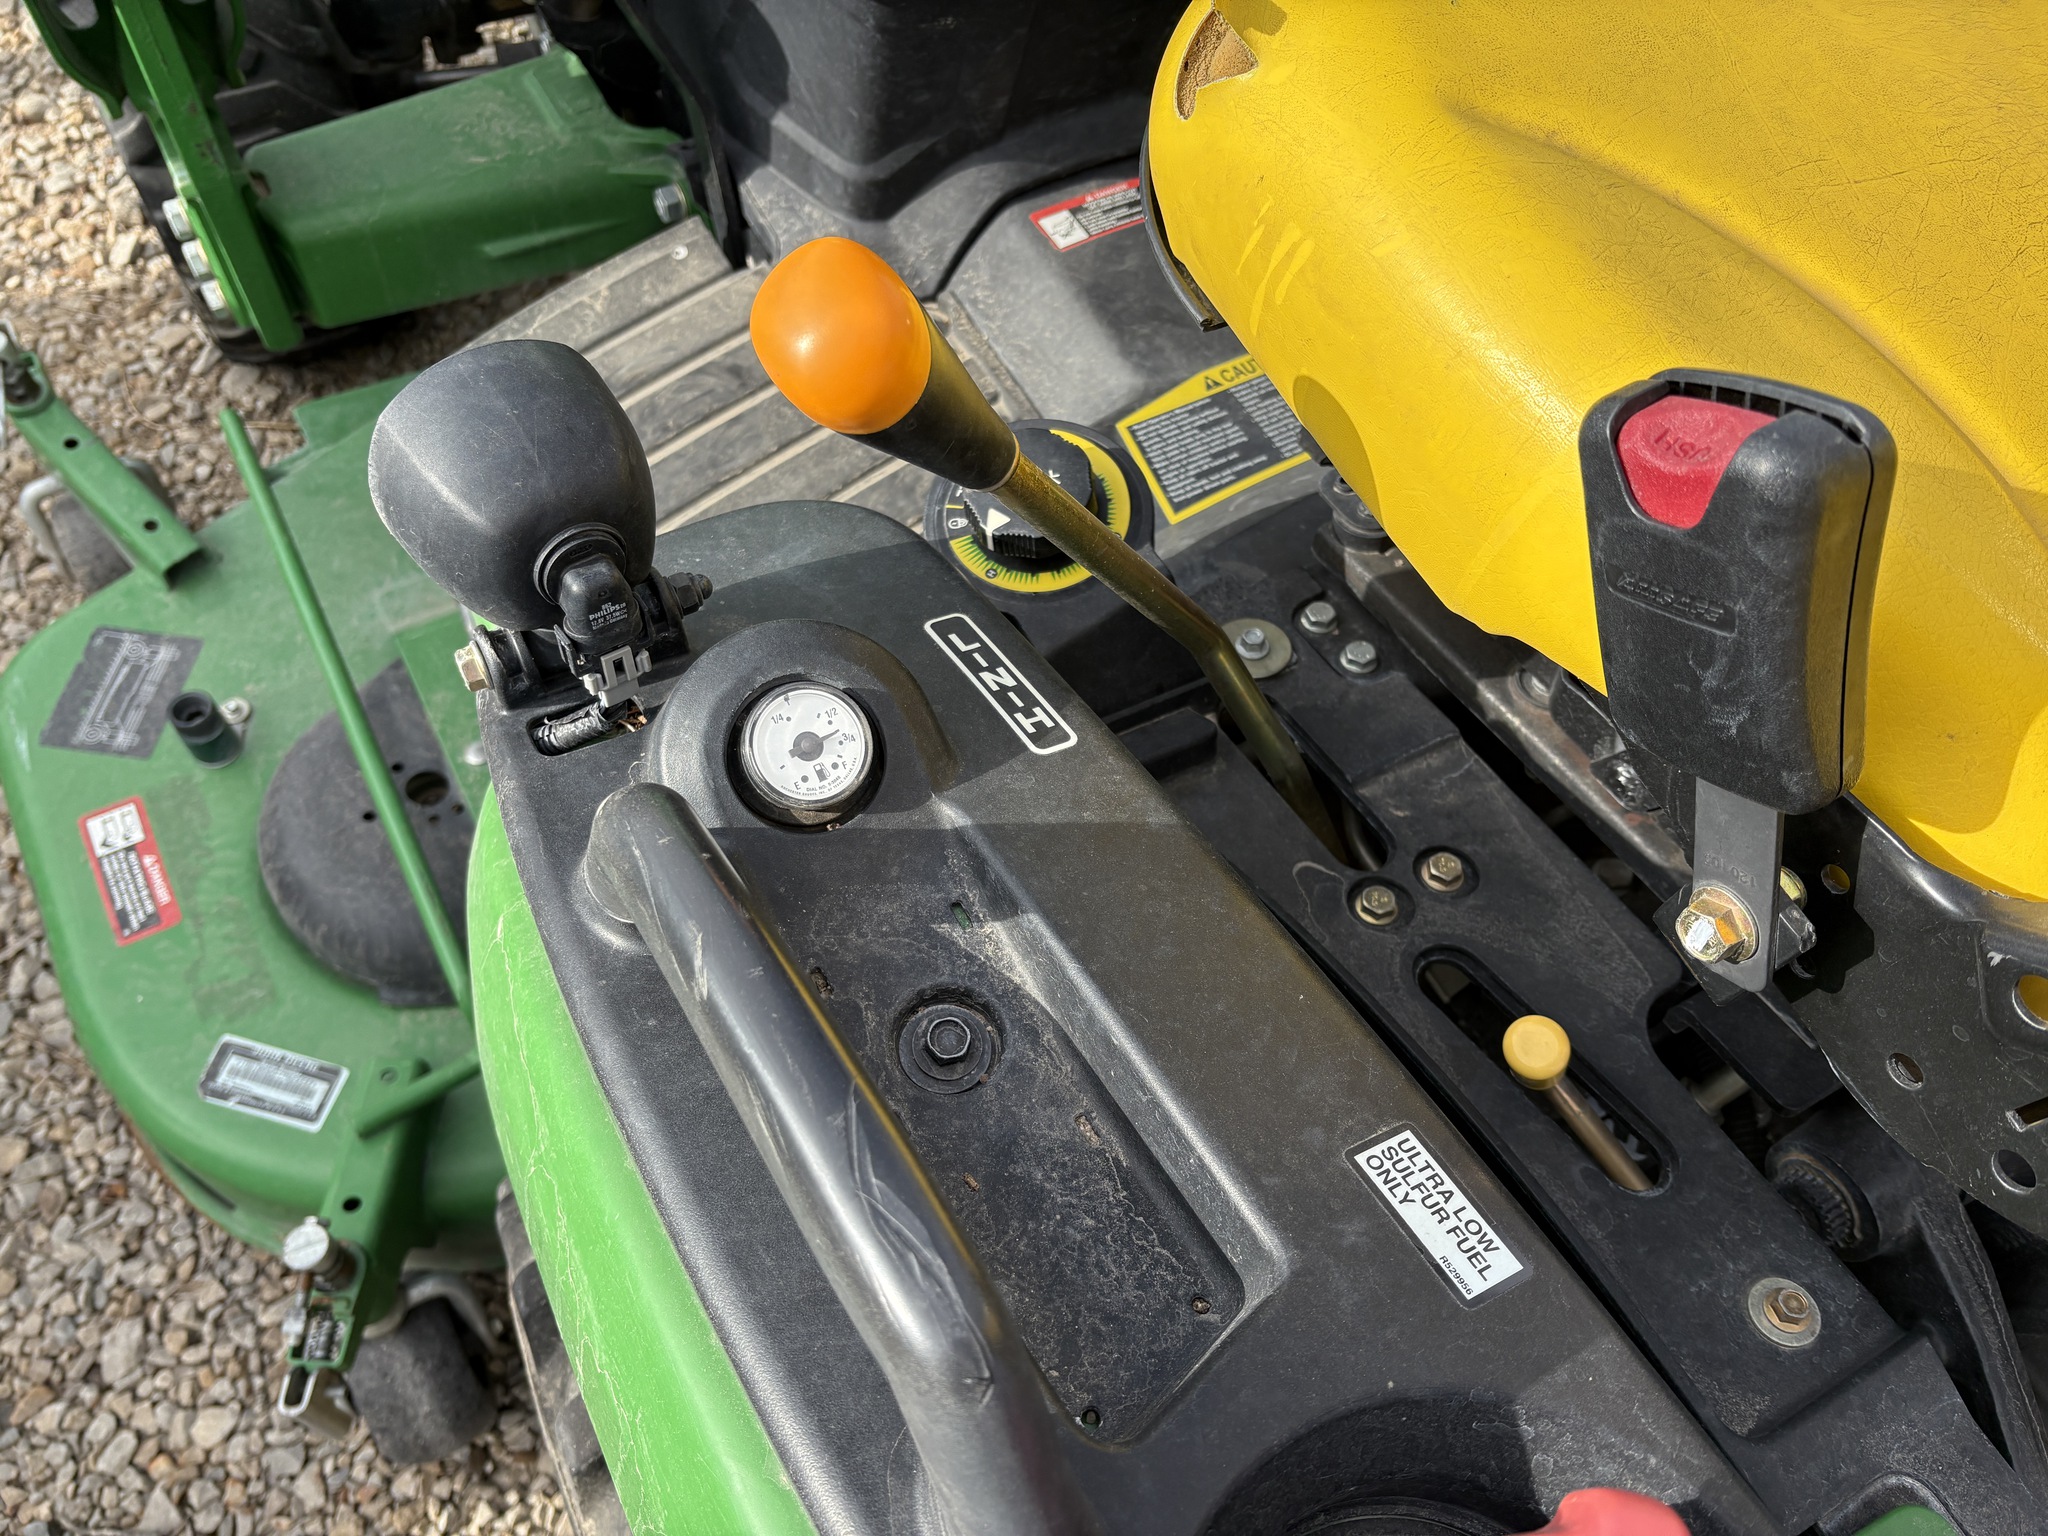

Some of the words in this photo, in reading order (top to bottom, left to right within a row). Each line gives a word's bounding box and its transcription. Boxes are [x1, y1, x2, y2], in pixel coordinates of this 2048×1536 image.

[1219, 360, 1256, 383] CAU
[589, 604, 620, 620] PHILIPS
[771, 713, 784, 725] 1/4
[824, 707, 839, 719] 1/2
[842, 732, 856, 743] 3/4
[841, 760, 848, 770] F
[793, 781, 801, 790] E
[1366, 1154, 1417, 1206] ONLY
[1397, 1137, 1455, 1205] ULTRA
[1452, 1206, 1500, 1253] LOW
[1381, 1145, 1451, 1225] SULFUR
[1445, 1224, 1493, 1282] FUEL
[1439, 1255, 1474, 1296] R529956
